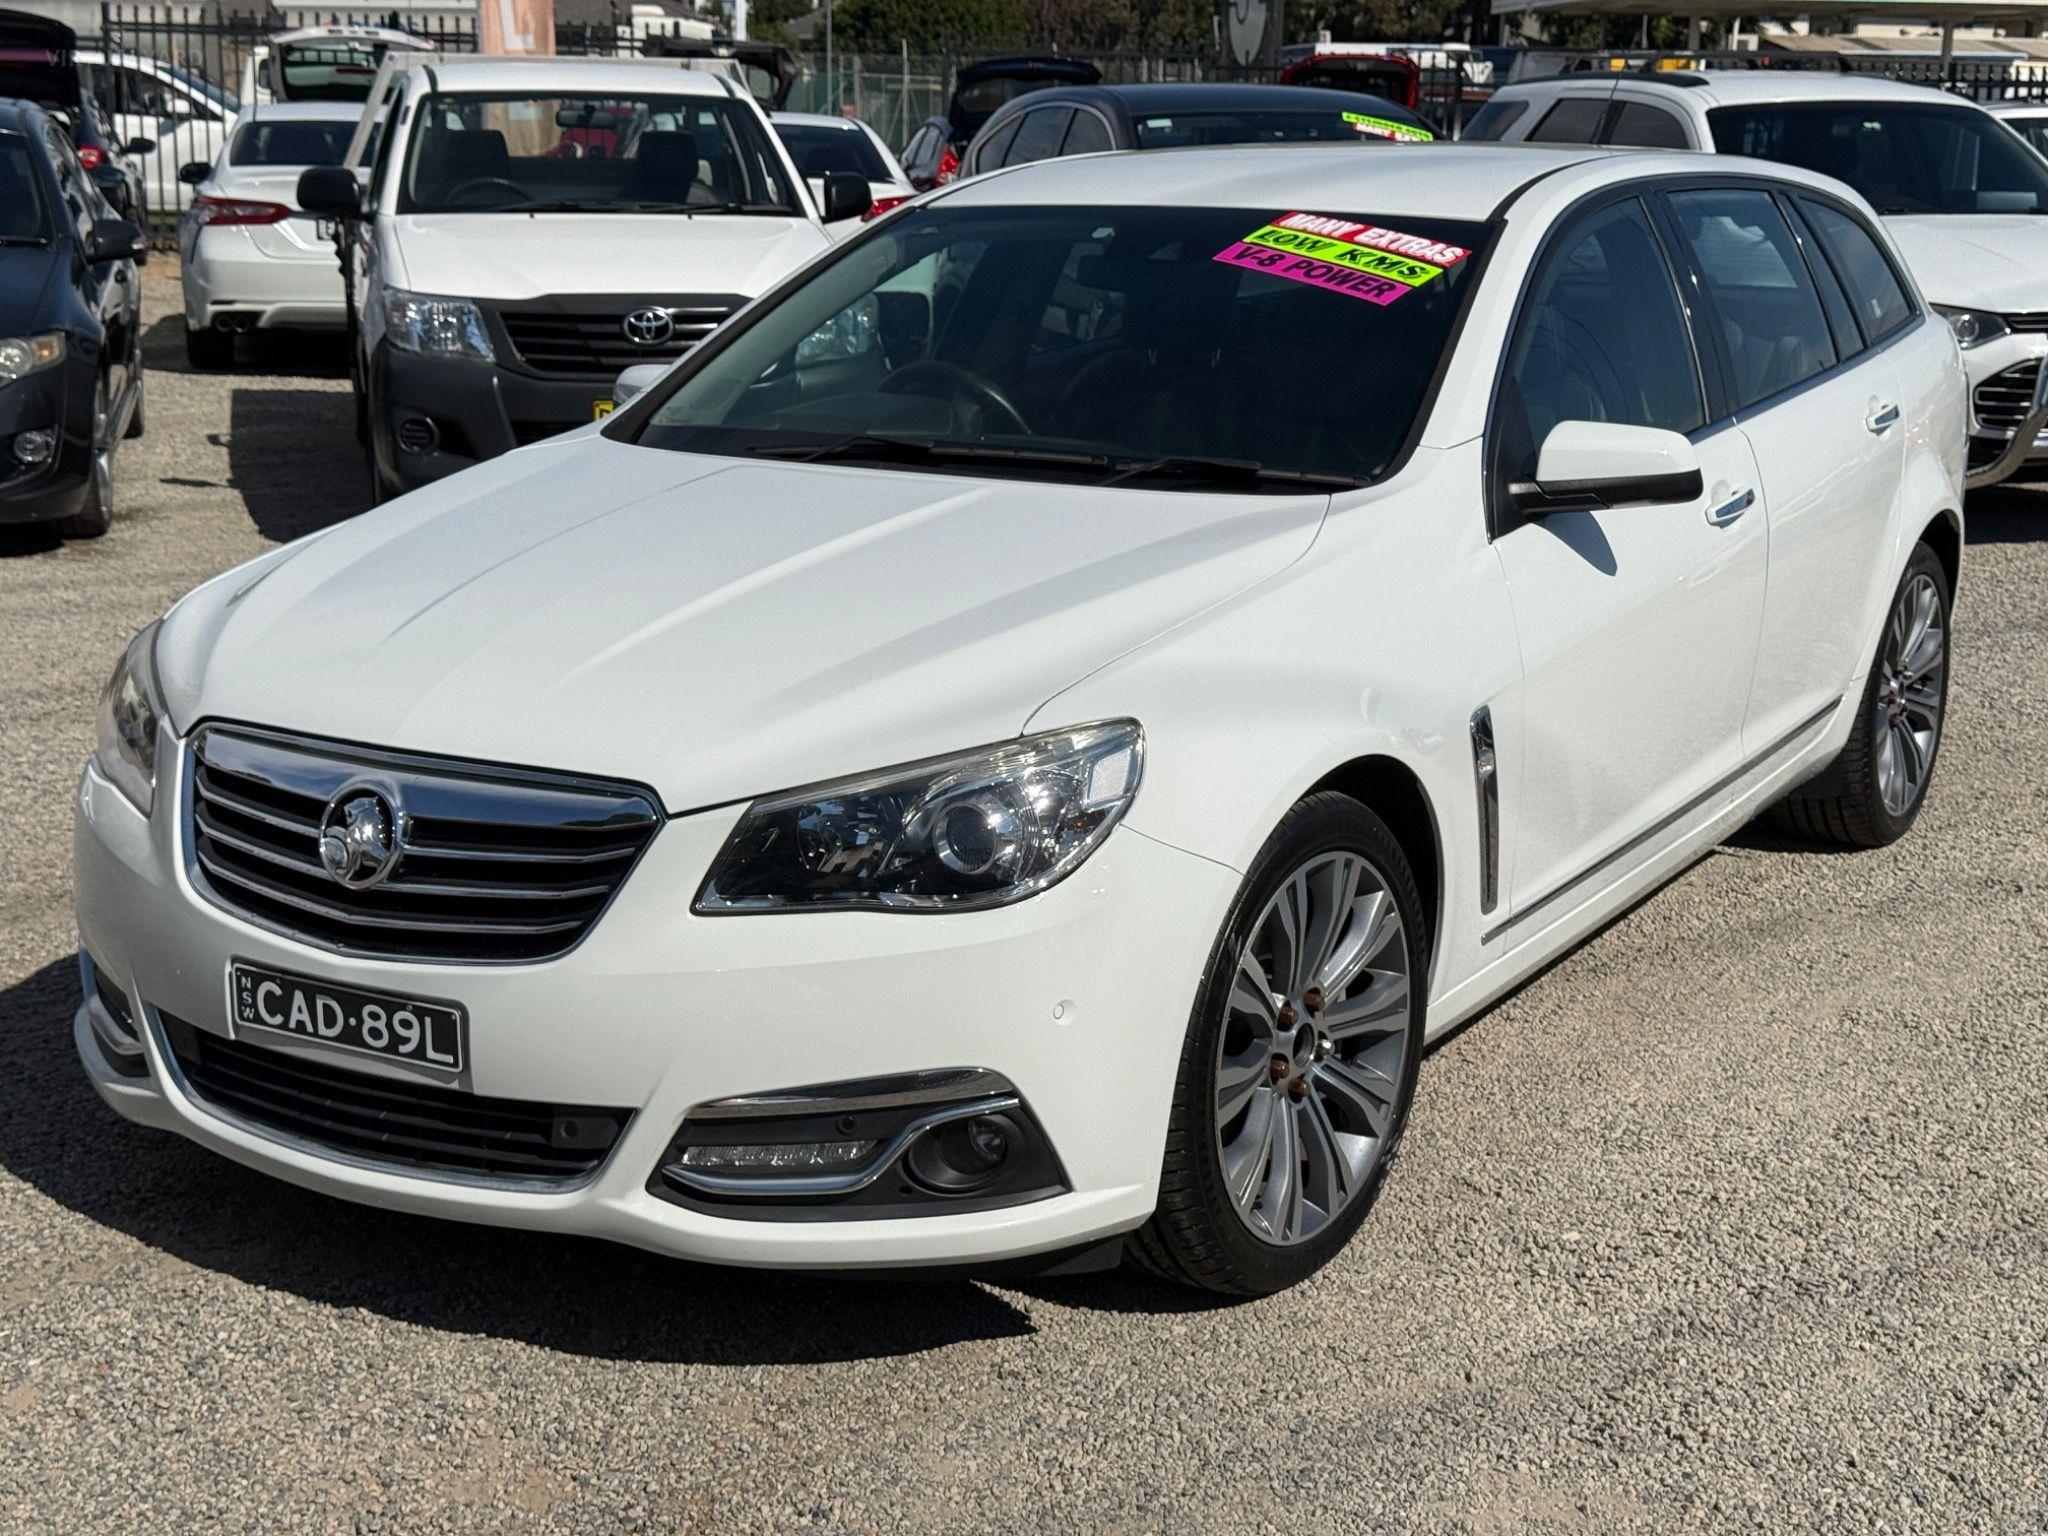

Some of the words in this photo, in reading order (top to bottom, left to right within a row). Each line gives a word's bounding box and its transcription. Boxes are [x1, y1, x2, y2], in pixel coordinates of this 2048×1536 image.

[1252, 229, 1337, 254] LOW
[1334, 248, 1429, 279] KMS
[1280, 212, 1364, 238] MANY
[1353, 228, 1465, 264] EXTRAS
[1232, 246, 1286, 267] V-8
[1282, 260, 1397, 298] POWER
